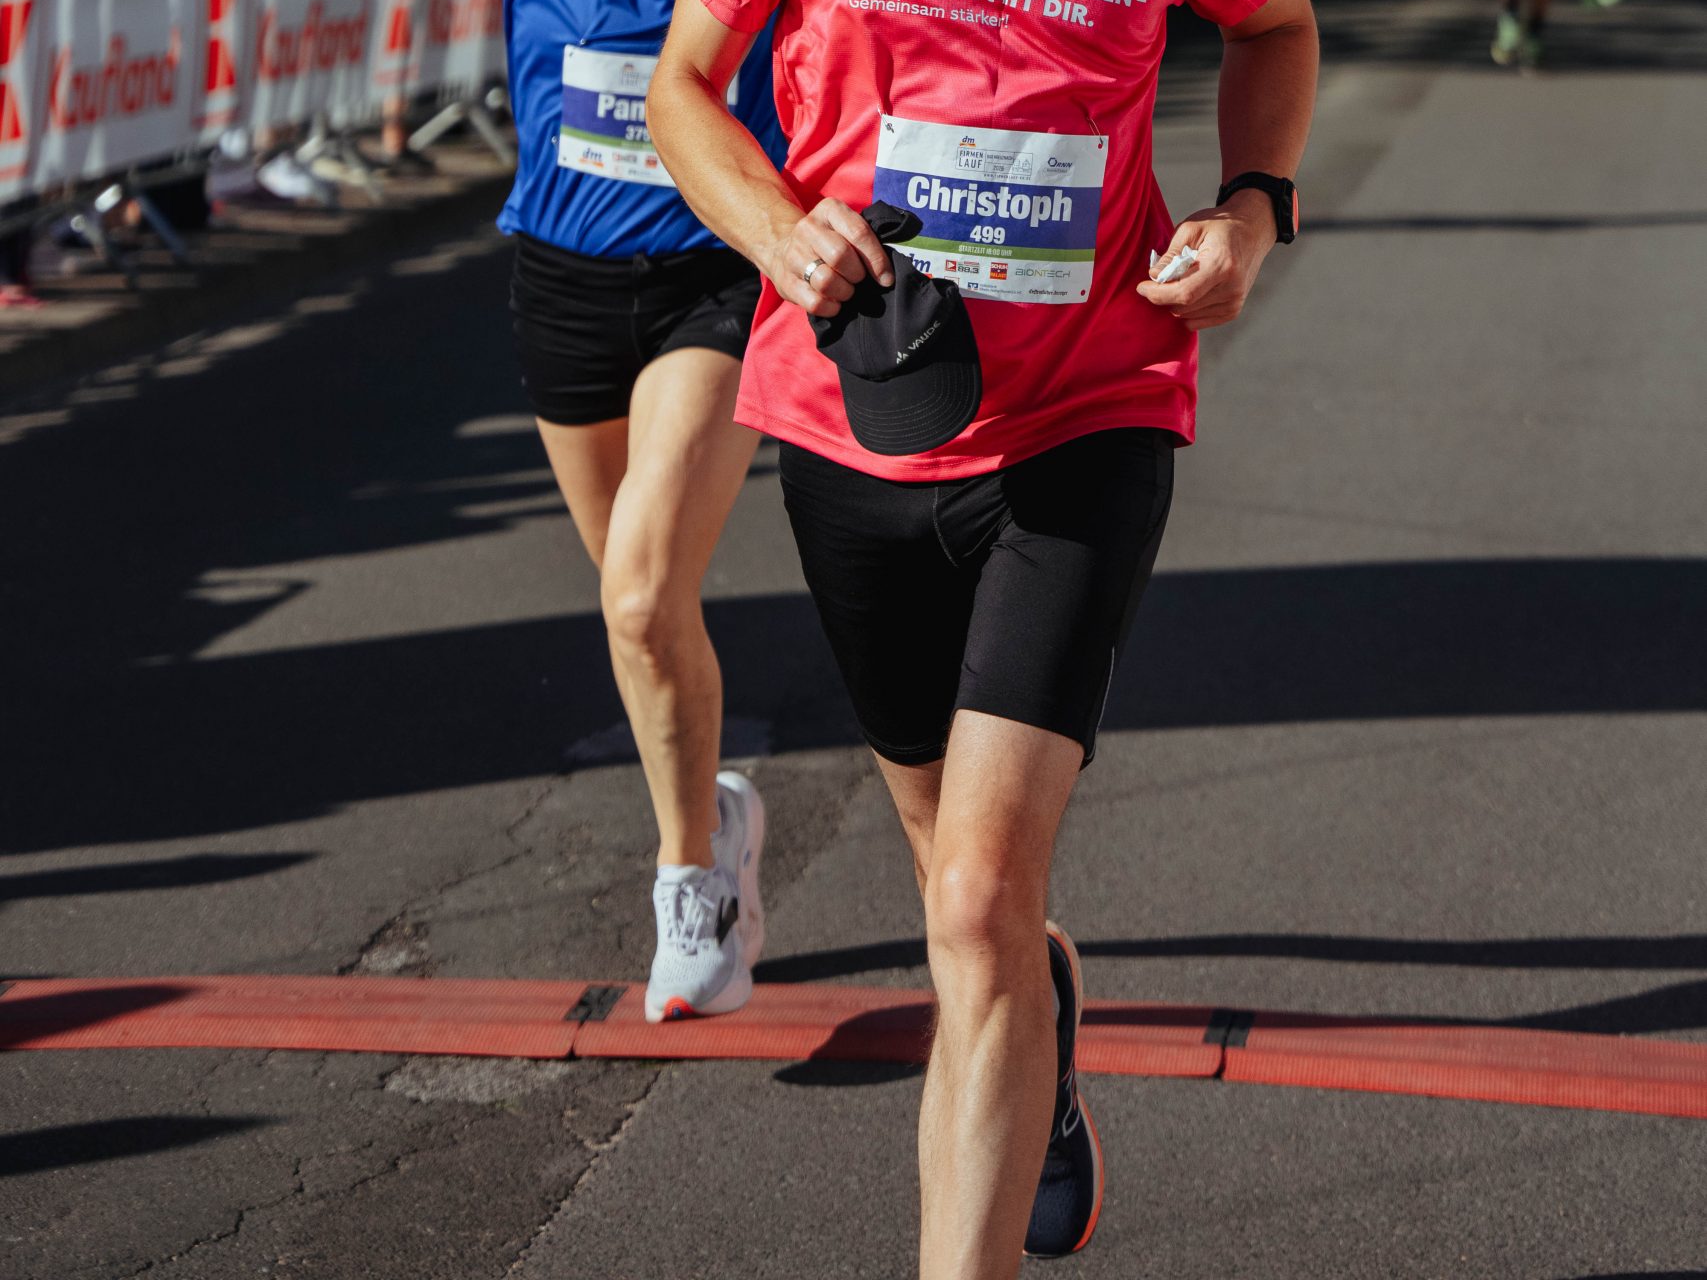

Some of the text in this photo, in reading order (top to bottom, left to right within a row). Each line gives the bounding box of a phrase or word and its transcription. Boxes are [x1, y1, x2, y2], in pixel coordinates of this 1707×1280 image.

[949, 7, 1010, 29] stärker!
[48, 26, 182, 130] Kaufland
[958, 158, 983, 169] LAUF
[959, 150, 984, 159] FIRMEN
[906, 175, 1073, 228] Christoph
[969, 224, 1006, 245] 499
[958, 265, 979, 274] 88.3
[907, 320, 942, 351] VAUDE
